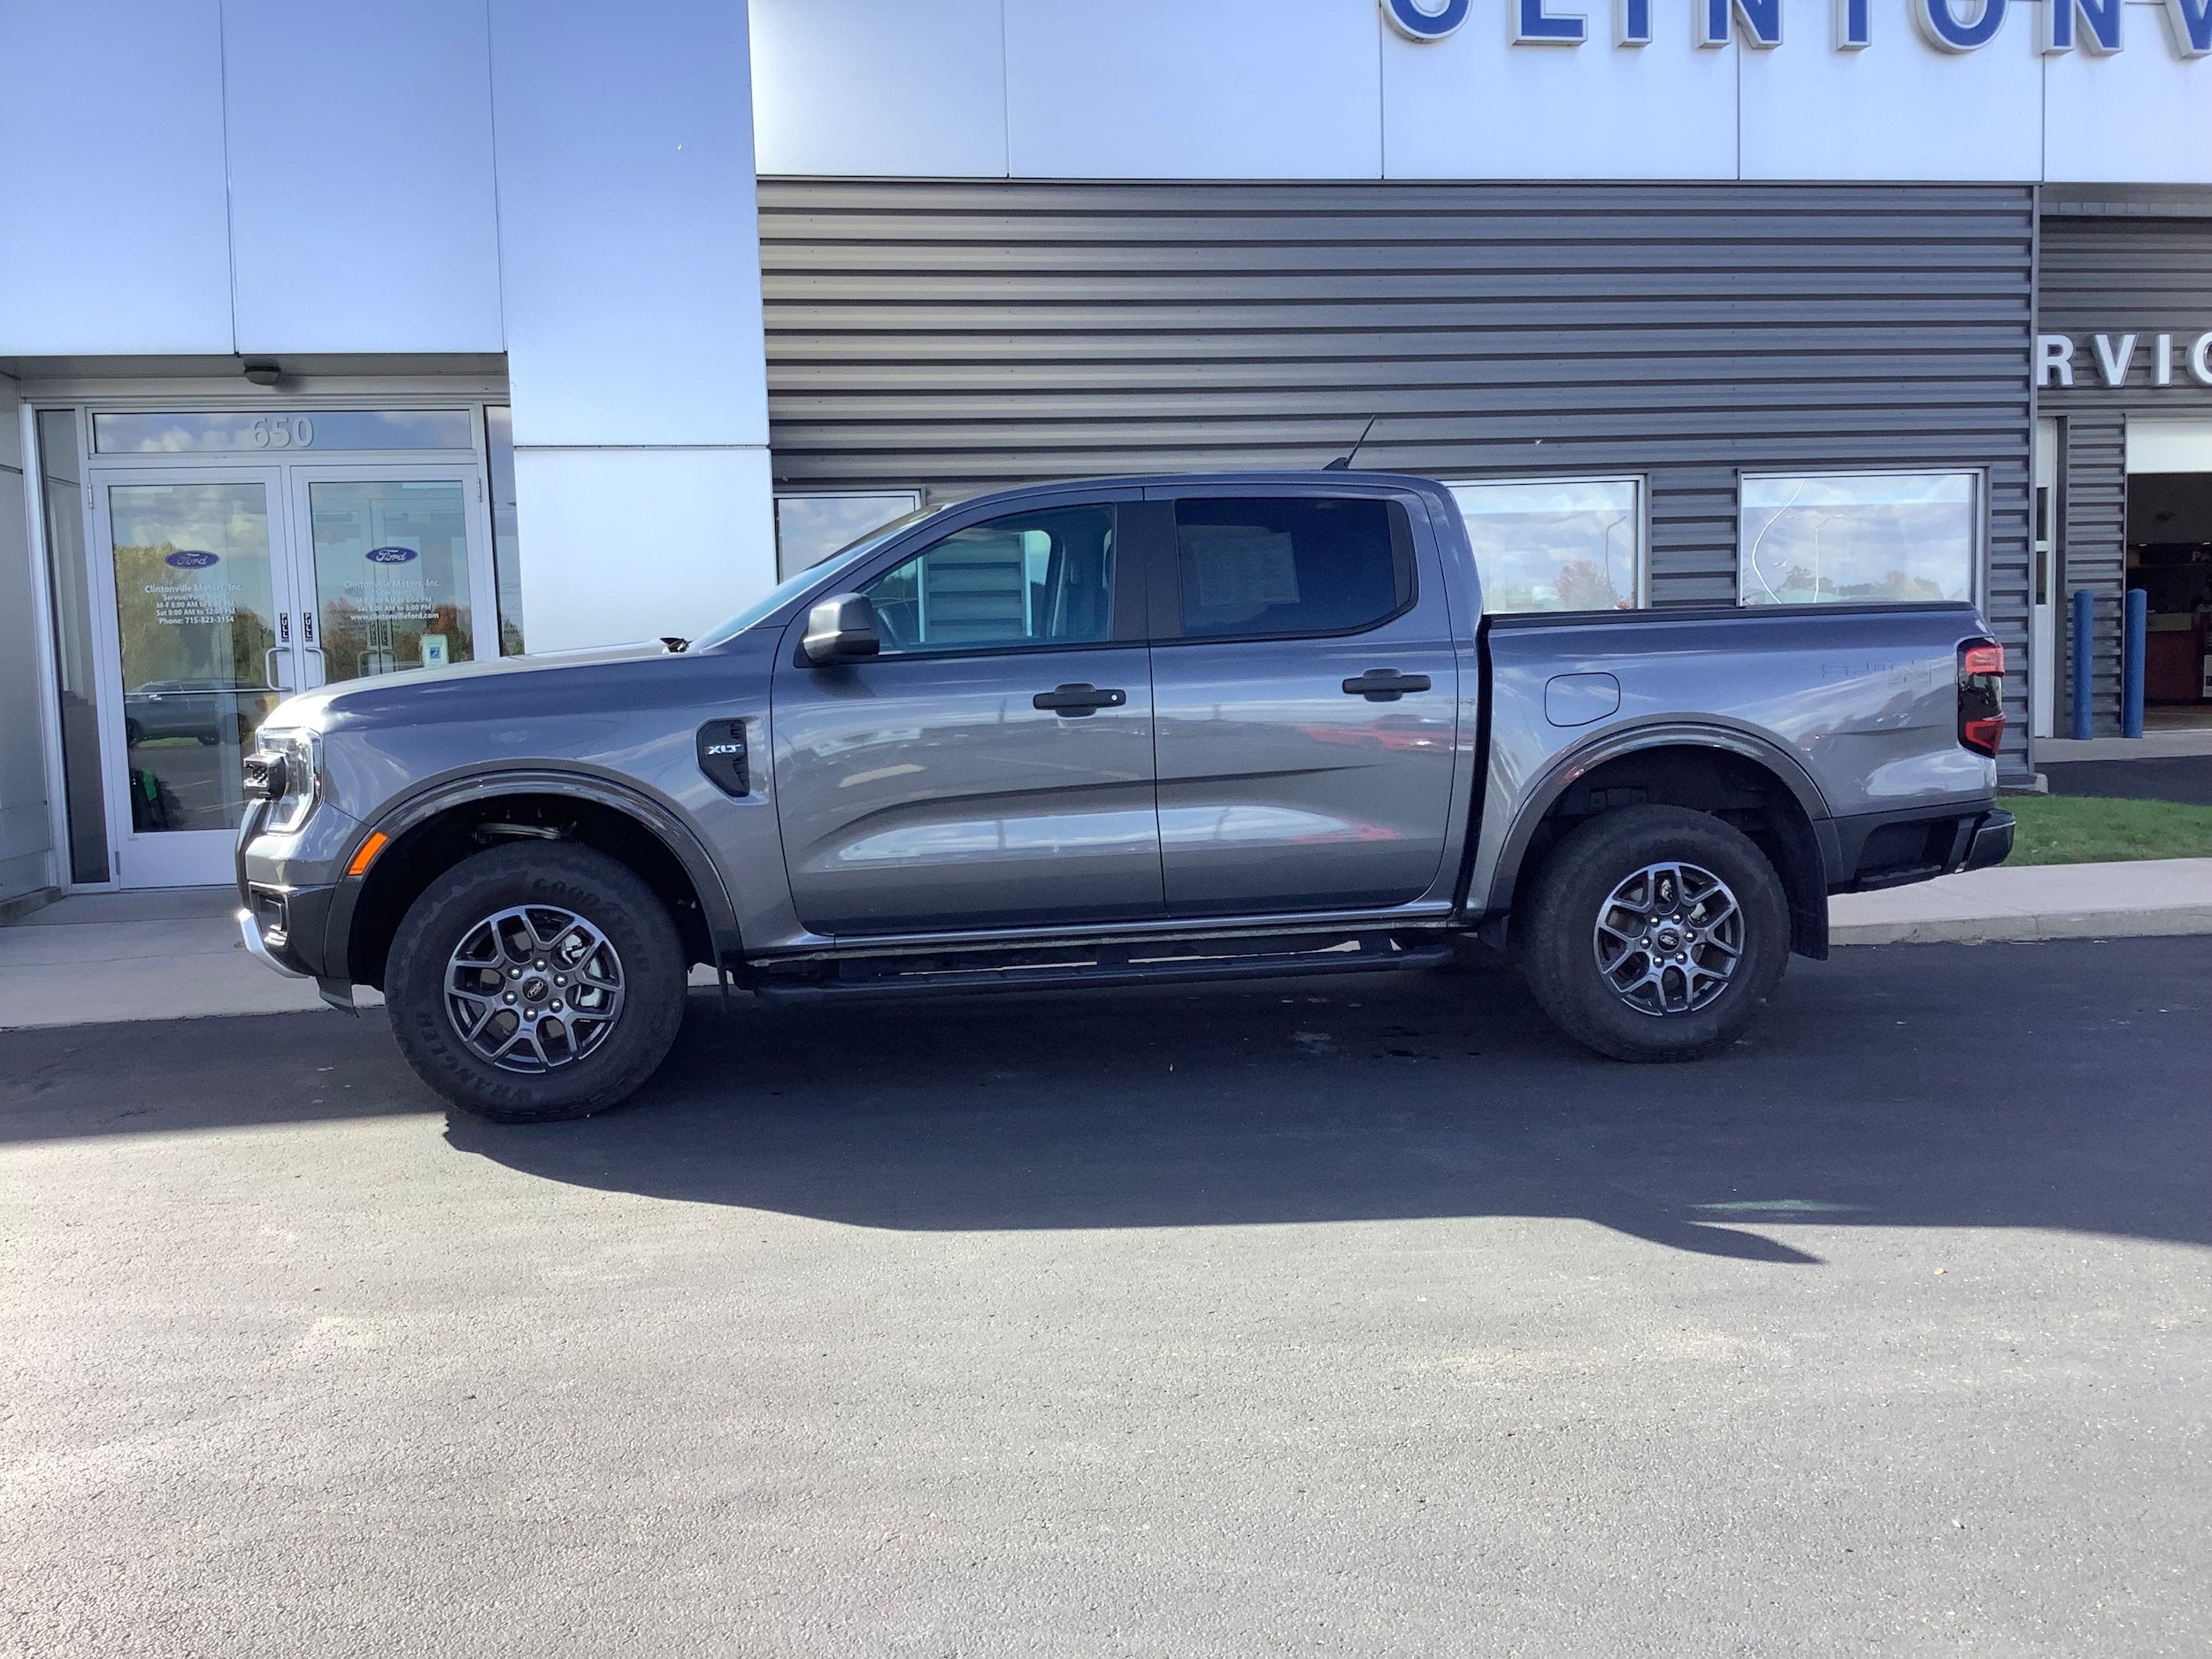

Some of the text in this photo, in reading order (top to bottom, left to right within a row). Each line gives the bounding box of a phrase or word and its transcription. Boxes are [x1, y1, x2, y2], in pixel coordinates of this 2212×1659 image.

[251, 416, 314, 448] 650
[144, 585, 192, 594] Clintonville
[350, 612, 440, 621] www.clintonvilleford.com
[708, 744, 741, 755] XLT
